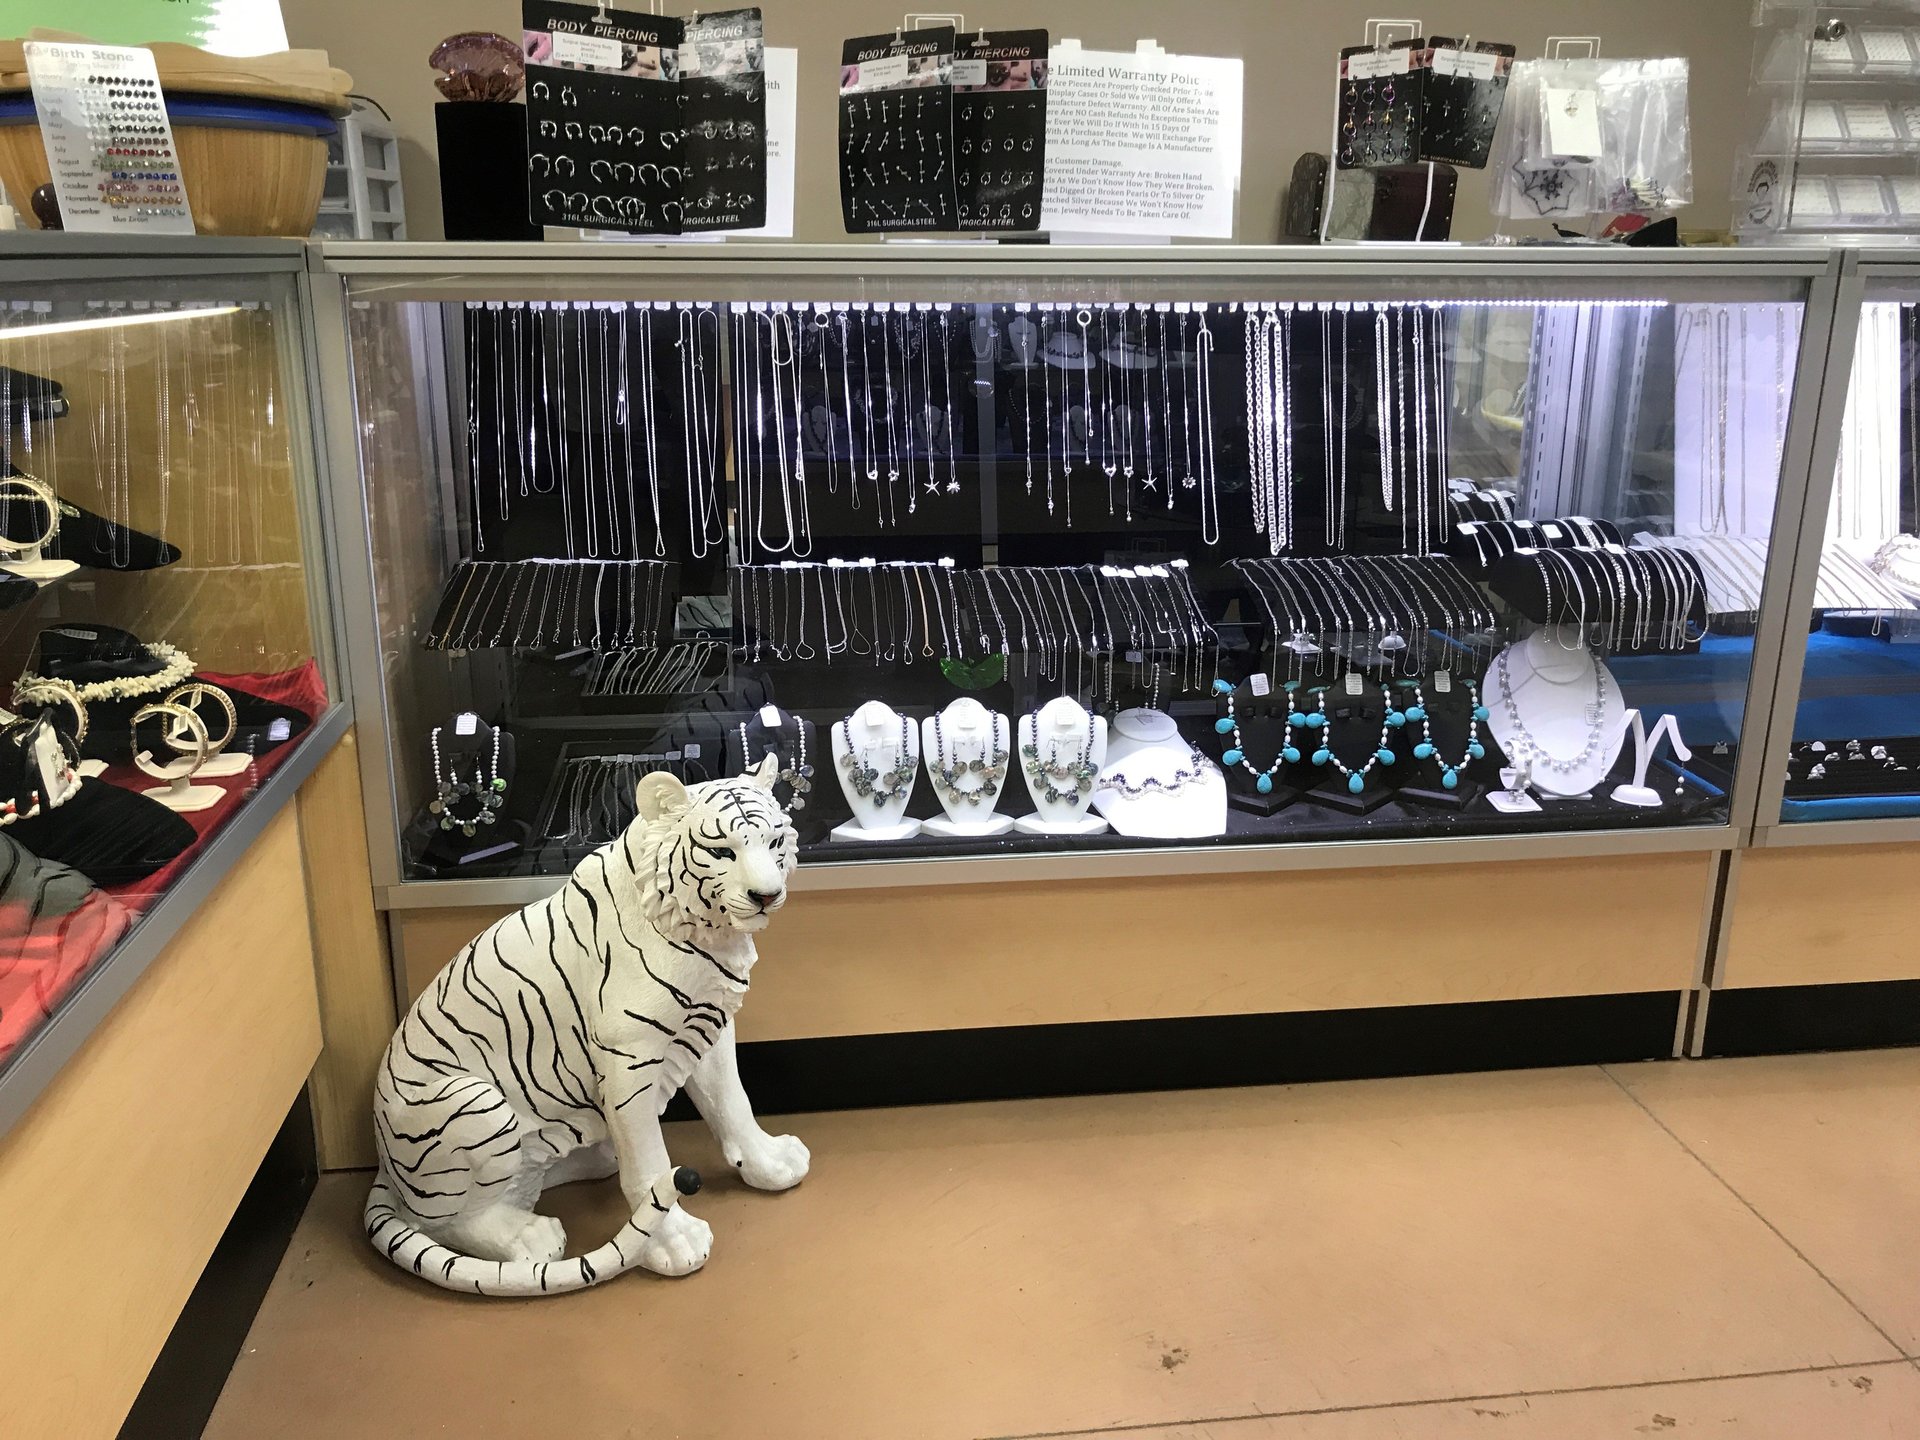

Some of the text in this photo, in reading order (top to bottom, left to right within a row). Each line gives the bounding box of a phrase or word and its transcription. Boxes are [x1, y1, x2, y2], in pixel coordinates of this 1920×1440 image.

[547, 18, 659, 43] BODY PIERCING
[685, 24, 743, 42] PIERCING
[50, 48, 135, 62] Birth Stone
[857, 42, 938, 61] BODY PIERCING
[973, 46, 1031, 59] PIERCING
[1057, 65, 1105, 78] Limited
[1109, 67, 1167, 85] Warranty
[1171, 72, 1200, 85] Polic
[766, 81, 780, 90] ith
[1068, 80, 1091, 88] Pieces
[1093, 81, 1106, 89] Are
[1108, 82, 1139, 93] Properly
[1140, 84, 1171, 94] Checked
[1049, 89, 1076, 98] Display
[1077, 90, 1098, 98] Cases
[1142, 94, 1157, 102] Will
[1158, 95, 1175, 104] Only
[1176, 97, 1194, 105] Offer
[1088, 100, 1111, 108] Defect
[1206, 108, 1219, 116] Are
[1107, 111, 1137, 119] Refunds
[1151, 114, 1190, 123] Exceptions
[1192, 116, 1201, 124] To
[1203, 117, 1218, 125] This
[1072, 118, 1085, 126] We
[1086, 119, 1101, 127] Will
[1122, 121, 1140, 129] With
[1151, 123, 1160, 131] 15
[1162, 124, 1179, 133] Days
[1181, 125, 1190, 133] Of
[1063, 128, 1069, 136] A
[1071, 128, 1104, 136] Purchase
[1131, 131, 1144, 139] We
[1146, 132, 1160, 140] Will
[1162, 133, 1196, 143] Exchange
[1198, 135, 1211, 143] For
[1071, 139, 1090, 147] Long
[1102, 139, 1115, 147] The
[1117, 140, 1146, 150] Damage
[1164, 143, 1213, 153] Manufacturer
[1055, 157, 1090, 166] Customer
[1044, 166, 1074, 175] Covered
[1076, 167, 1099, 175] Under
[1100, 168, 1136, 178] Warranty
[1154, 171, 1180, 180] Broken
[1182, 172, 1203, 181] Hand
[1103, 178, 1124, 186] Know
[1145, 180, 1163, 190] They
[1164, 181, 1184, 190] Were
[1087, 187, 1096, 195] Or
[1098, 188, 1124, 196] Broken
[1162, 191, 1171, 199] To
[1172, 192, 1193, 200] Silver
[1041, 196, 1069, 204] ratched
[1071, 197, 1092, 205] Silver
[1094, 197, 1124, 206] Because
[1125, 199, 1138, 207] We
[1163, 201, 1184, 209] Know
[1186, 202, 1203, 210] How
[1061, 206, 1089, 216] Jewelry
[1091, 207, 1113, 215] Needs
[1115, 208, 1124, 216] To
[1126, 209, 1136, 217] Be
[1138, 210, 1160, 218] Taken
[1162, 210, 1179, 219] Care
[562, 213, 655, 228] 316L SURGICALSTEEL
[866, 217, 937, 227] 316L SURGICALSTEEL
